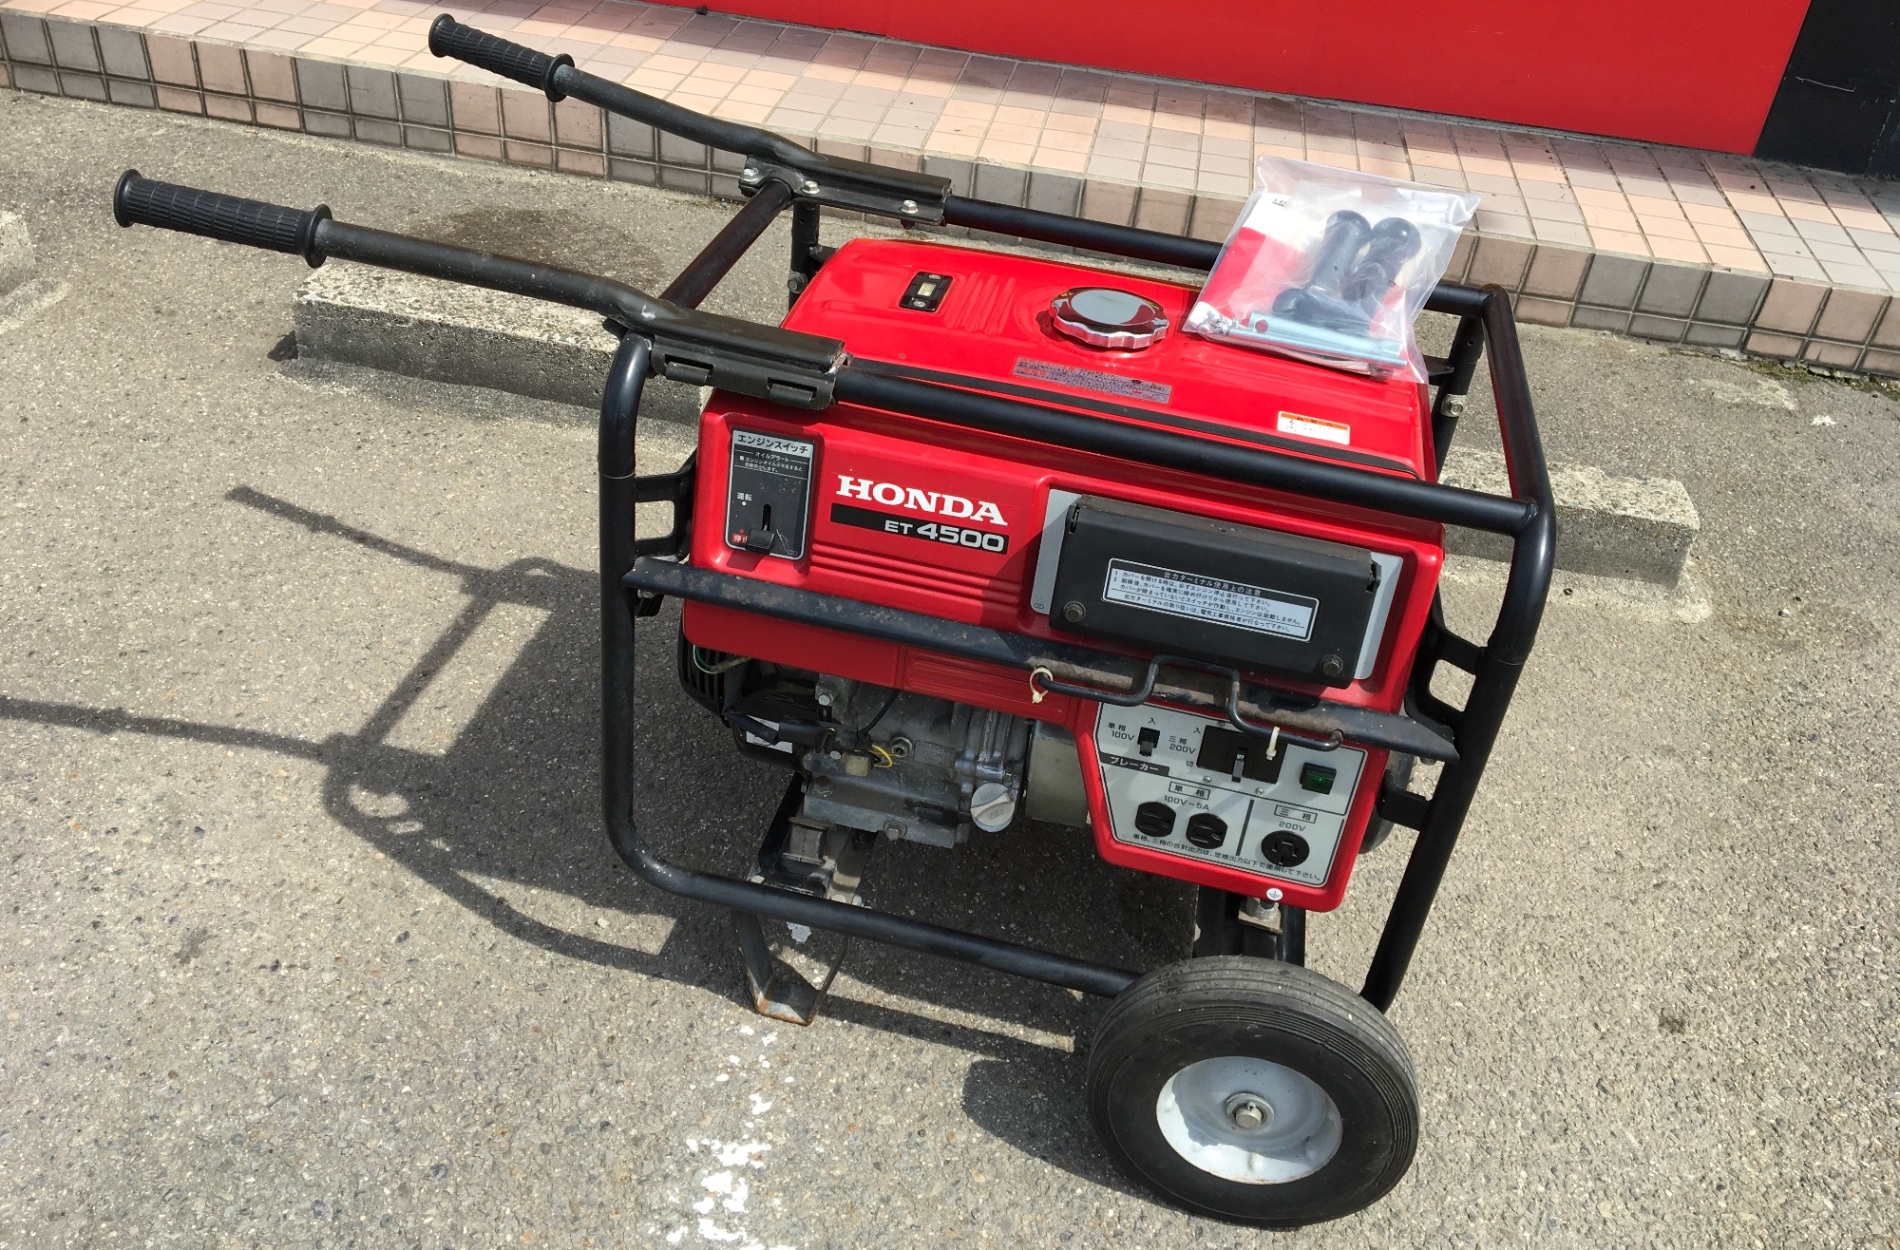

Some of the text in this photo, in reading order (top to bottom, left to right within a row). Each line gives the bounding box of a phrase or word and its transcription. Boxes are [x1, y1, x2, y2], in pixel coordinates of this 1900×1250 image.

[737, 434, 808, 454] エンジンスイッチ
[836, 474, 1008, 526] HONDA
[884, 519, 1005, 552] ET 4500
[1148, 717, 1156, 725] 入
[1111, 730, 1135, 741] 100V
[1193, 727, 1201, 735] 入
[1169, 743, 1196, 754] 200V
[1110, 756, 1159, 771] ブレーカー
[1173, 784, 1205, 798] 単相
[1279, 807, 1312, 821] 三相
[1278, 821, 1307, 832] 200V
